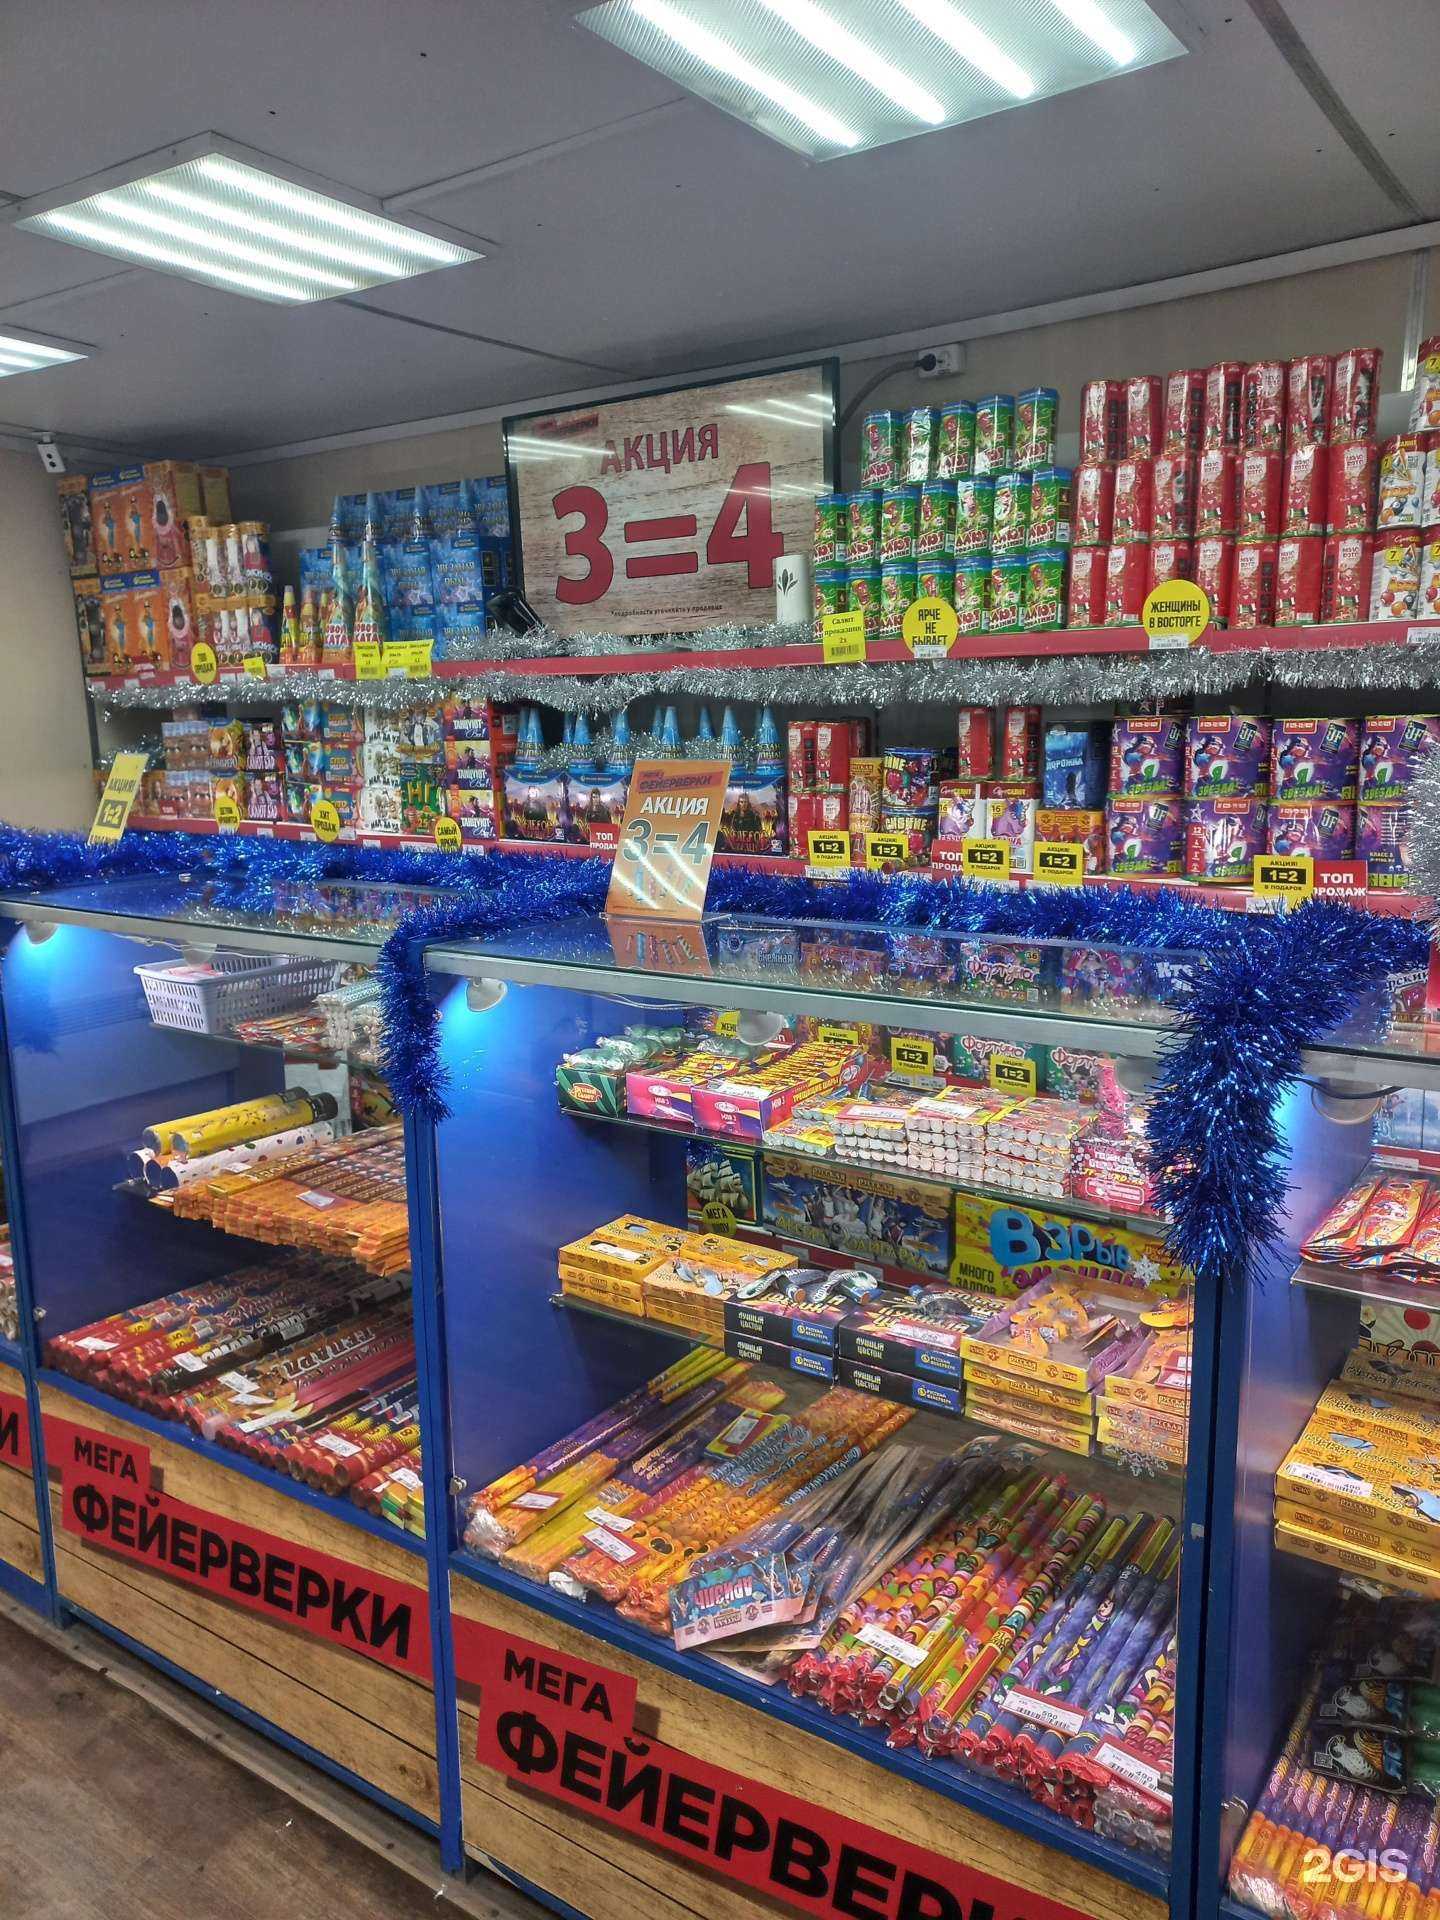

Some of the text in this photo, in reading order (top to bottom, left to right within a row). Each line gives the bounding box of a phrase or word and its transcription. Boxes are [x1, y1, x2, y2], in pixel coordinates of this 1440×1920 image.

[600, 423, 719, 474] АКЦИЯ
[552, 461, 784, 605] 3=4
[1150, 599, 1201, 613] ЖЕНЩИНЫ
[918, 608, 941, 621] ЯРЧЕ
[925, 622, 937, 634] НЕ
[1150, 616, 1201, 628] В ВОСТОРГЕ
[912, 635, 948, 647] БЫВАЕТ
[640, 796, 710, 819] АКЦИЯ
[595, 832, 614, 841] ТОП
[623, 818, 711, 865] 3=4
[819, 842, 840, 852] 1=2
[877, 846, 898, 855] 1=2
[939, 851, 963, 862] ТОП
[975, 852, 998, 862] 1=2
[1046, 856, 1071, 867] 1=2
[932, 863, 964, 872] ПРОДА
[1269, 870, 1299, 882] 1=2
[1319, 873, 1354, 884] ТОП
[901, 1051, 923, 1063] 1=2
[1002, 1067, 1024, 1080] 1=2
[706, 1208, 727, 1220] МЕГА
[959, 1262, 994, 1283] МНОГО
[74, 1436, 138, 1483] МЕГА
[73, 1483, 412, 1660] ФЕЙЕРВЕРКИ
[503, 1648, 613, 1724] МЕГА
[496, 1710, 1028, 1920] ФЕЙЕРВЕР
